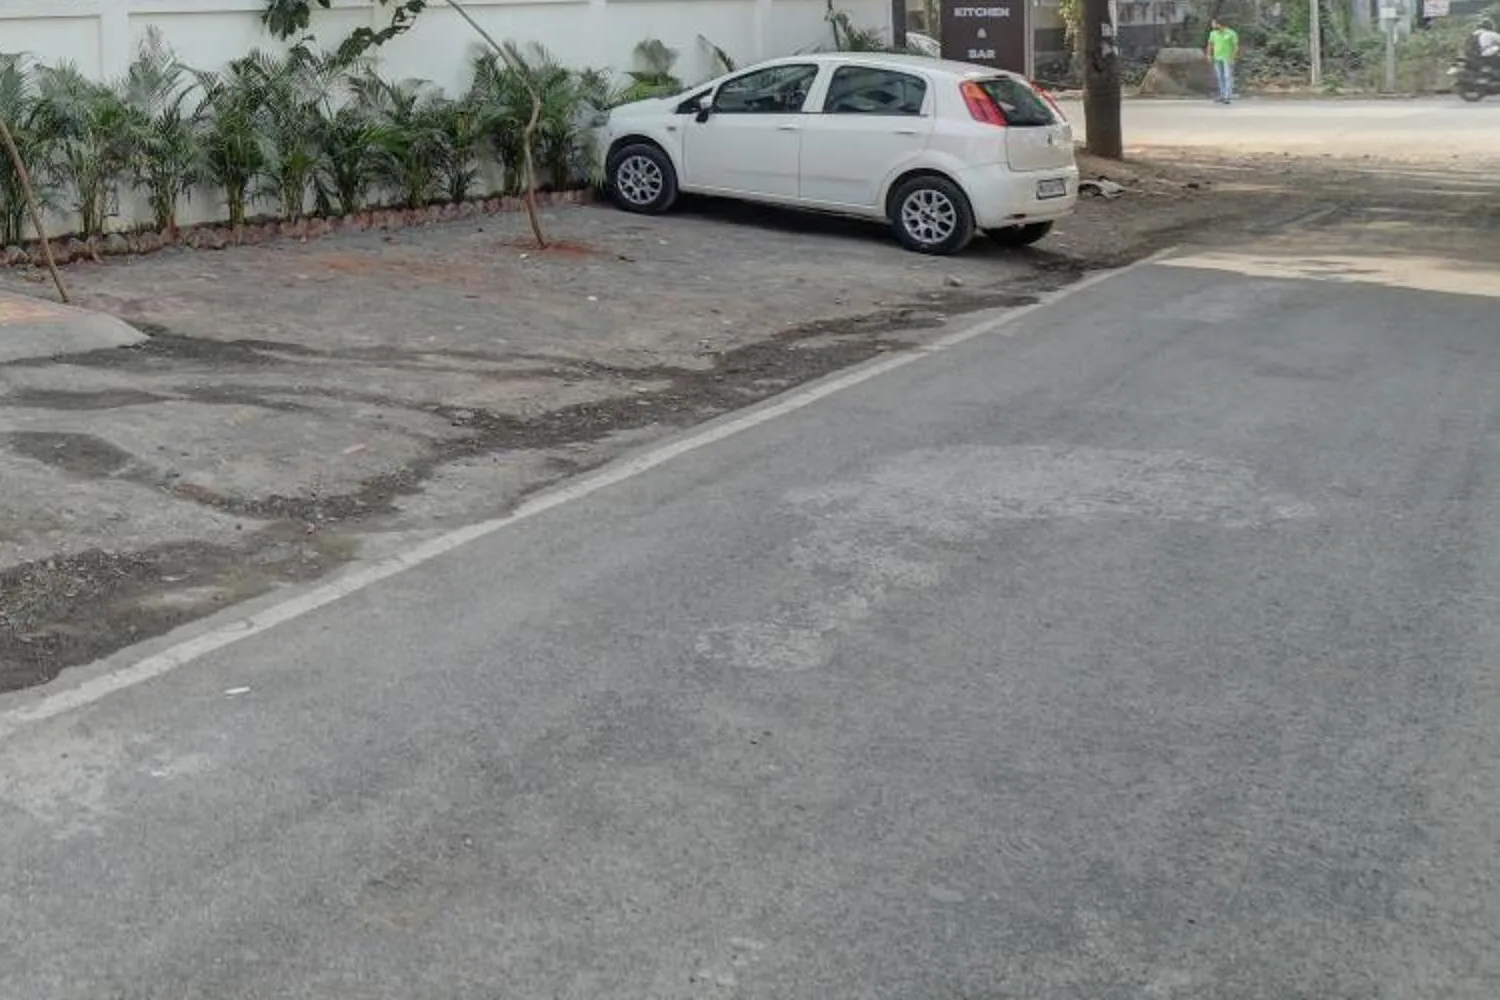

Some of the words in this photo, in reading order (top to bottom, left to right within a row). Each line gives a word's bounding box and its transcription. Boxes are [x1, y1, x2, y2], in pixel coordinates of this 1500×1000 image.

[954, 7, 1010, 17] KITCHEN
[977, 27, 987, 39] &
[968, 49, 996, 59] BAR
